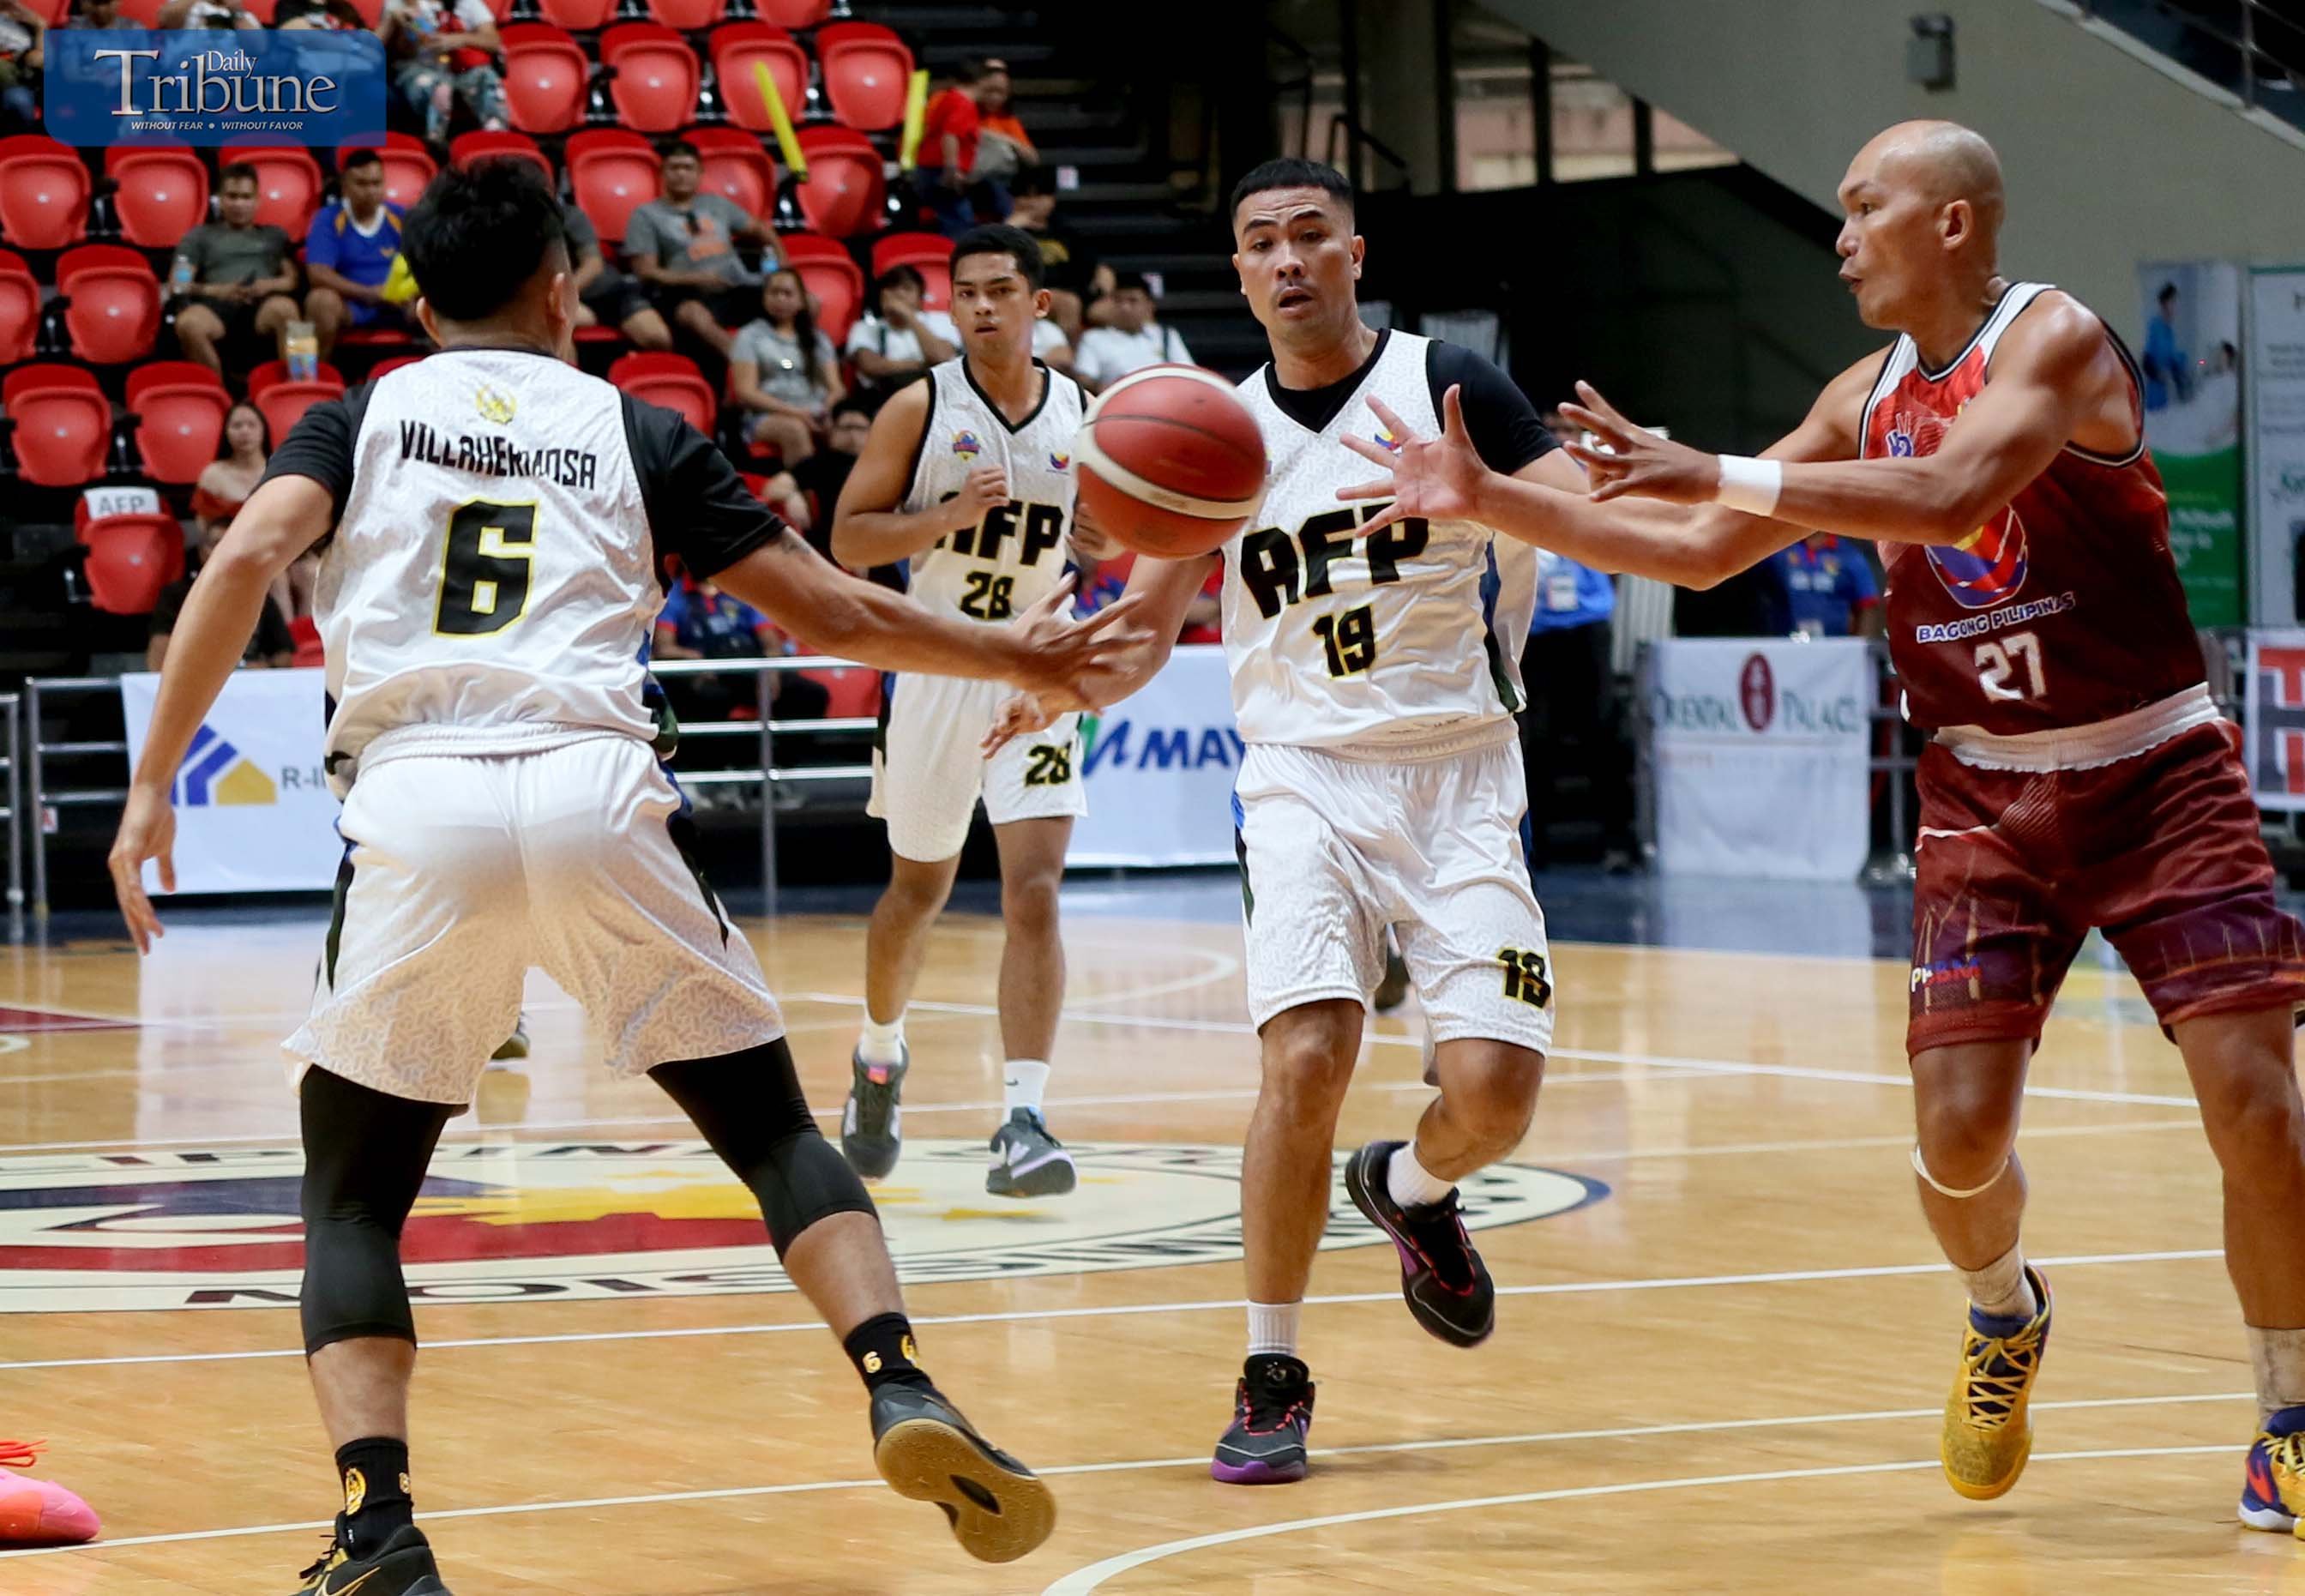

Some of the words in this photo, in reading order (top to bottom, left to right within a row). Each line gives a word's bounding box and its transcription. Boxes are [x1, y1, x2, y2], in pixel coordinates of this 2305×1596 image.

[432, 496, 540, 637] 6
[1240, 500, 1429, 619] AFP
[960, 569, 1014, 620] 28
[1917, 615, 1990, 644] BAGONG
[1991, 591, 2075, 629] PILIPINAS
[1311, 603, 1376, 678] 19
[1974, 630, 2048, 704] 27
[1025, 741, 1071, 787] 28
[863, 1351, 882, 1373] 6
